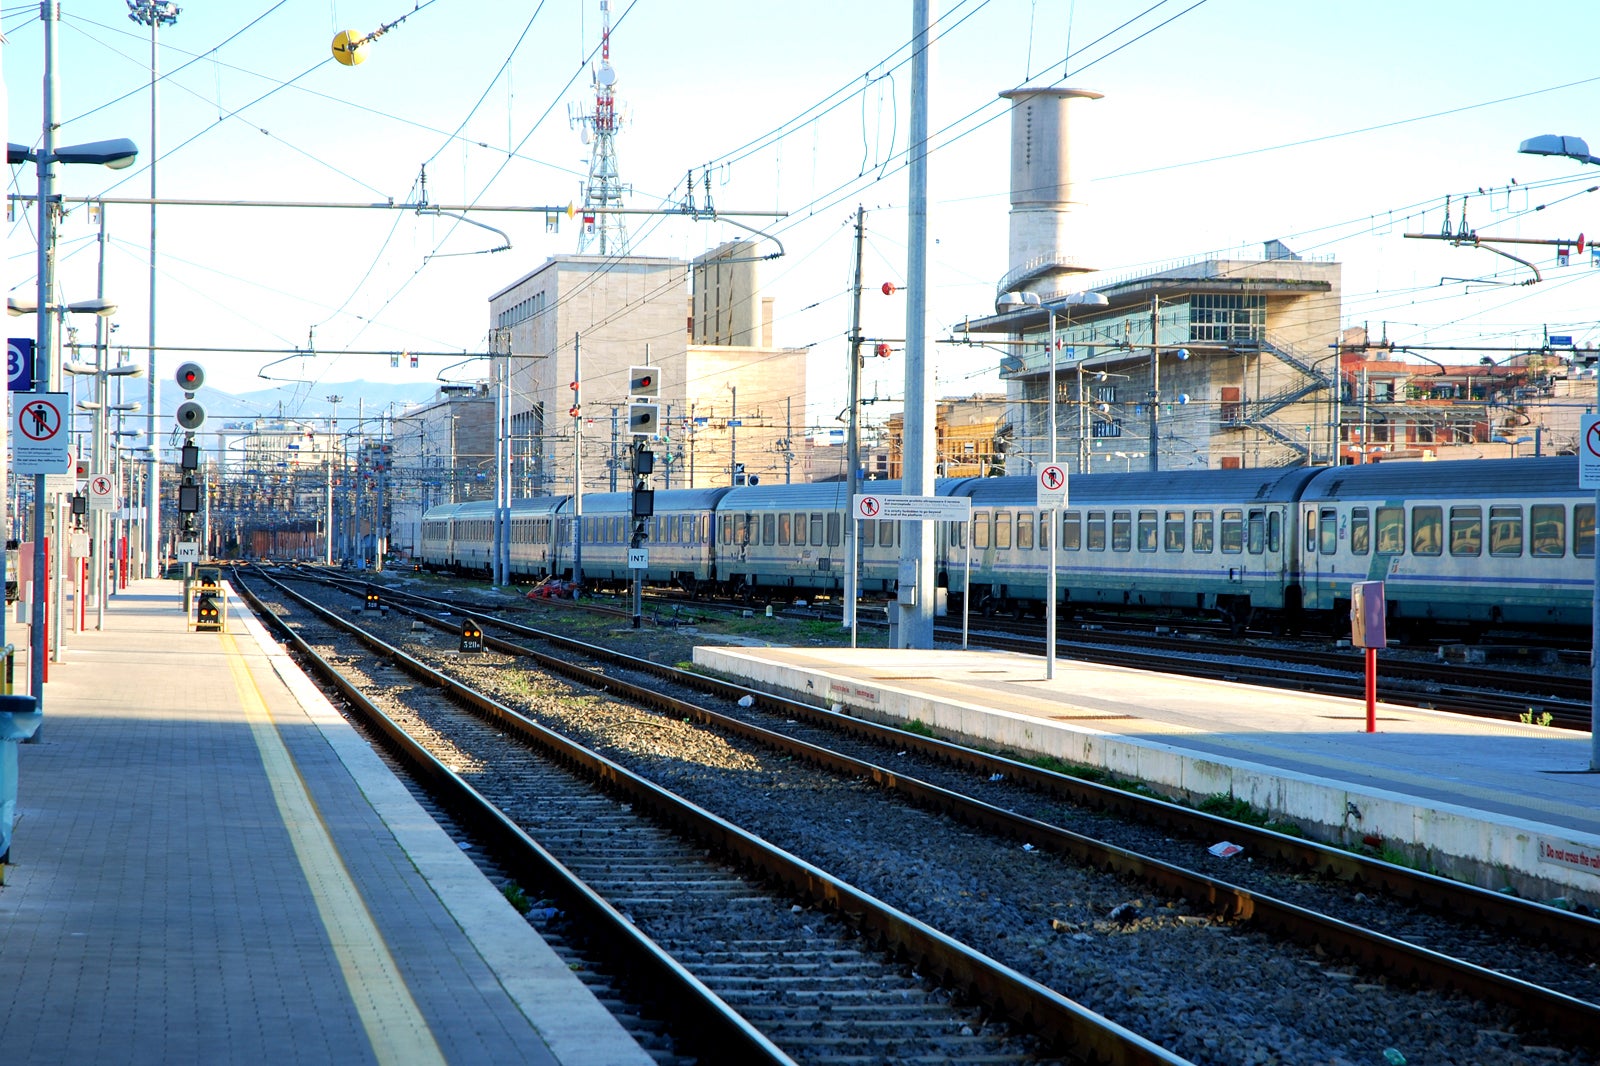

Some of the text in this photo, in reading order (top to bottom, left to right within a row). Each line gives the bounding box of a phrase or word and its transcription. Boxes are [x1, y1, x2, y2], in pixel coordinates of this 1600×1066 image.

[549, 223, 554, 231] 7
[1546, 843, 1554, 859] Do
[1554, 849, 1565, 861] not
[1565, 851, 1579, 865] cross
[1579, 850, 1590, 866] the
